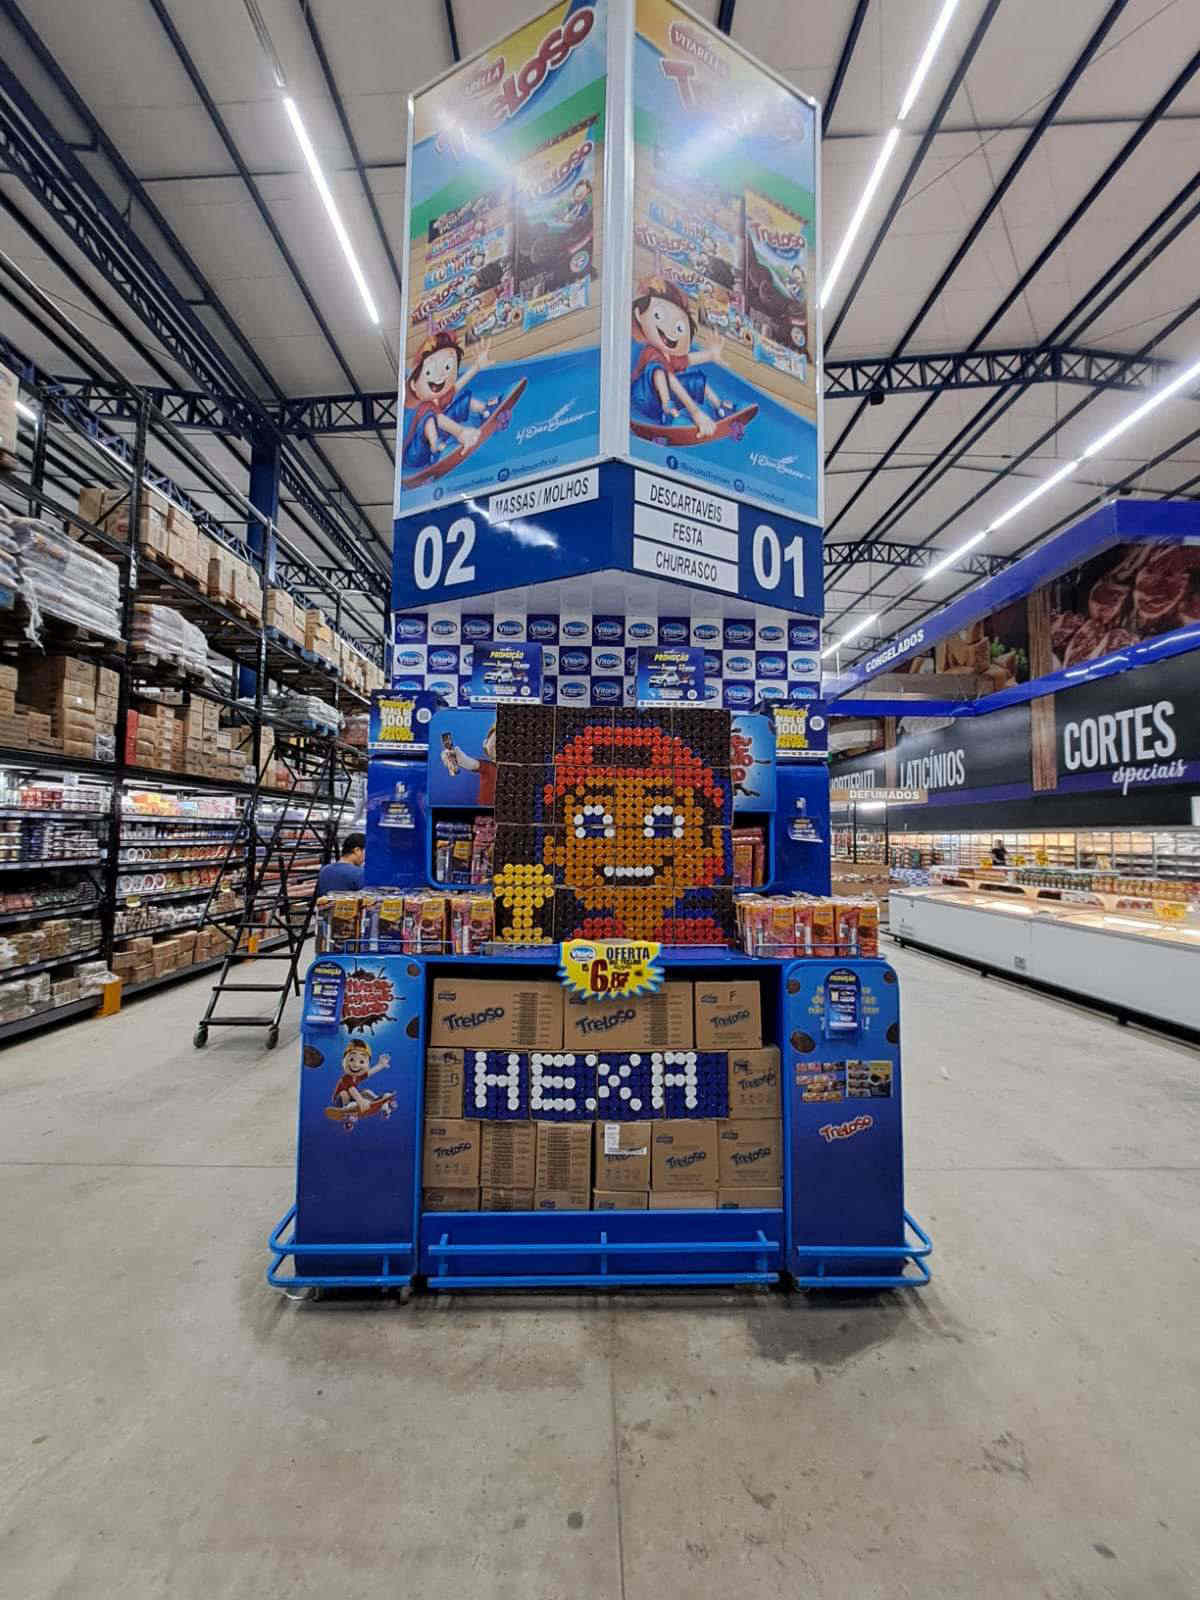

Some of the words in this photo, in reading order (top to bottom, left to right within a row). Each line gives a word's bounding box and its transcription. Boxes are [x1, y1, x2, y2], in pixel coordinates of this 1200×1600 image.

[495, 492, 537, 515] MASSAS
[543, 477, 590, 503] MOLHOS
[672, 523, 703, 547] FESTA
[414, 518, 476, 590] 02
[656, 551, 718, 582] CHURRASCO
[753, 525, 804, 598] 01
[865, 629, 925, 673] CONGELADOS
[1063, 700, 1177, 770] CORTES
[900, 749, 965, 791] LATICÍNIOS
[1112, 759, 1188, 796] especiais
[849, 789, 921, 800] DEFUMADOS
[606, 947, 650, 960] OFERTA
[443, 1007, 505, 1031] Treloso
[575, 1007, 637, 1034] Treloso
[710, 1009, 750, 1029] Treloso
[474, 1051, 698, 1111] HEXA
[819, 1114, 874, 1143] Treloso
